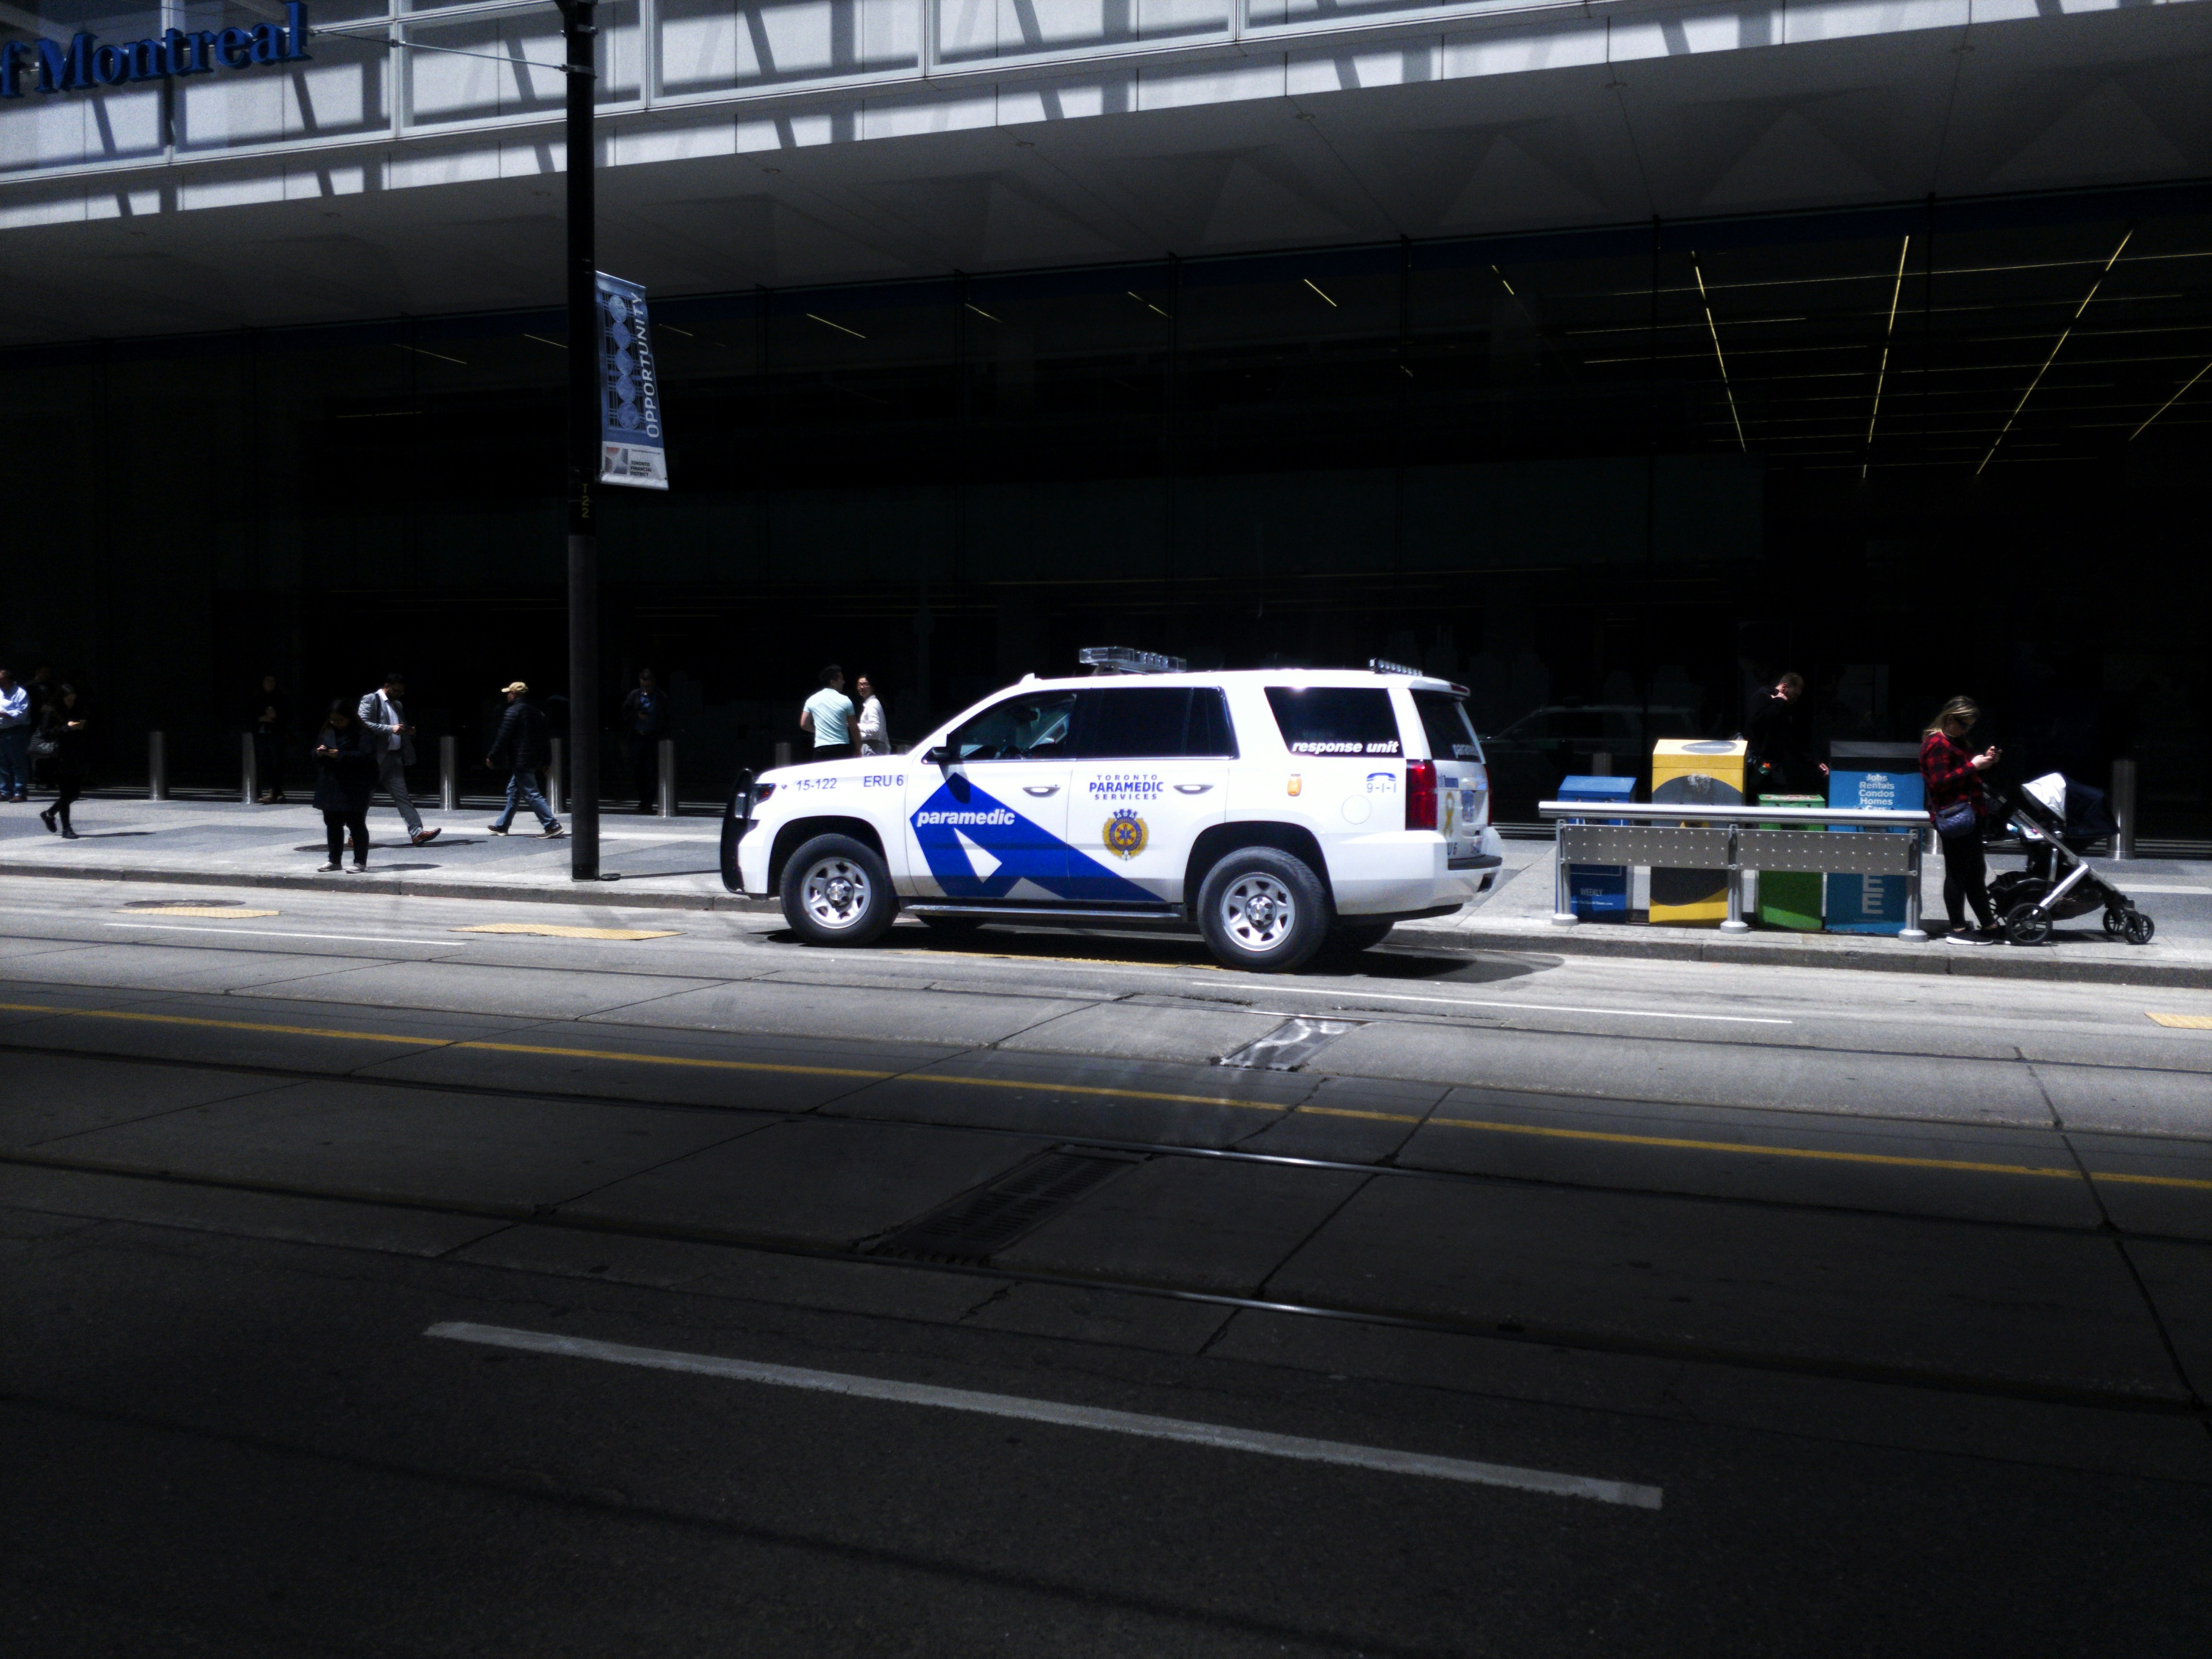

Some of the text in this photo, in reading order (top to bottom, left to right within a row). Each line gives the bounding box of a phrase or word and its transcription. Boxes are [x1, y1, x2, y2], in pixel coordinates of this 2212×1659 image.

[35, 0, 313, 94] Montreal
[632, 292, 660, 439] OPPORTUNITY
[1291, 740, 1399, 754] response unit
[797, 774, 904, 791] 15-122 ERU 6
[1866, 773, 1888, 782] Jobs
[1089, 782, 1163, 792] PARAMEDIC
[1859, 782, 1895, 790] Rentals
[1859, 789, 1895, 797] Condos
[917, 809, 1015, 827] paramedic
